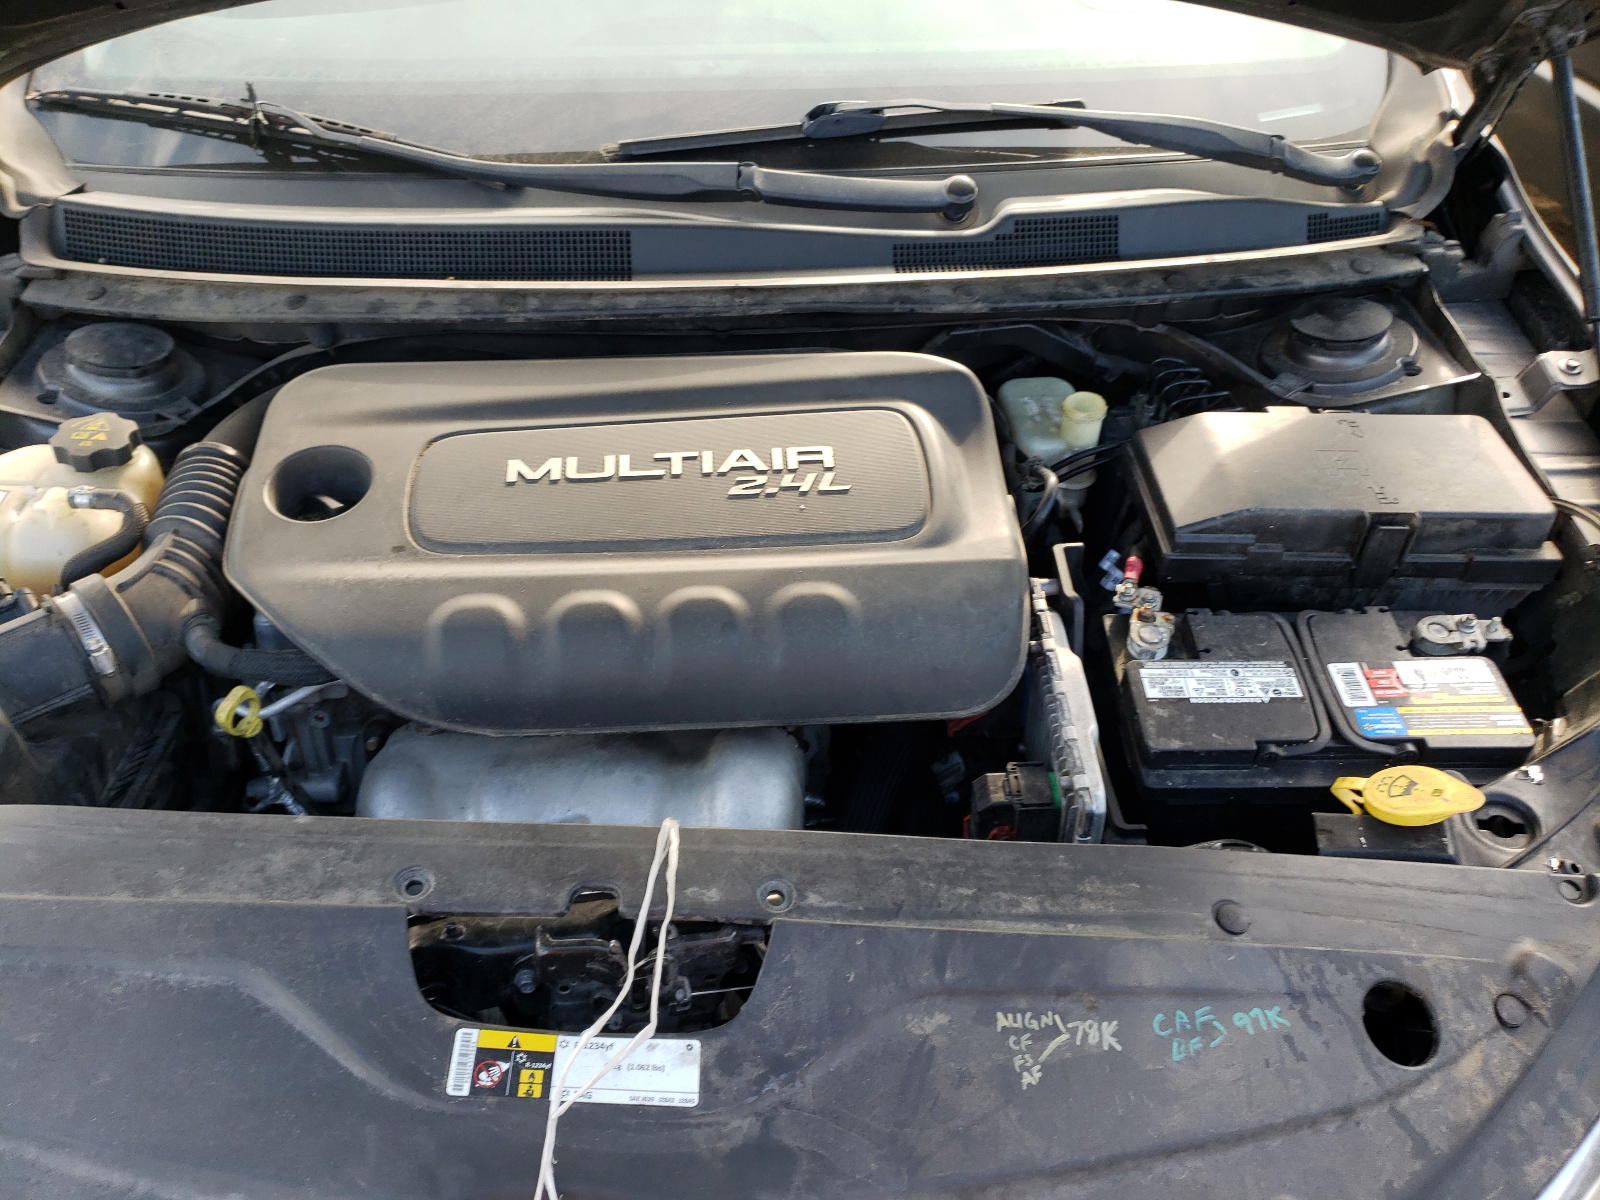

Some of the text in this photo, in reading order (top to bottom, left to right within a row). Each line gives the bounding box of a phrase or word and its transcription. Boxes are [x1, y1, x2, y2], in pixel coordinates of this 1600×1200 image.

[505, 445, 835, 485] MULTIAIR
[727, 472, 851, 498] 2.4L
[1067, 1020, 1122, 1051] 78K
